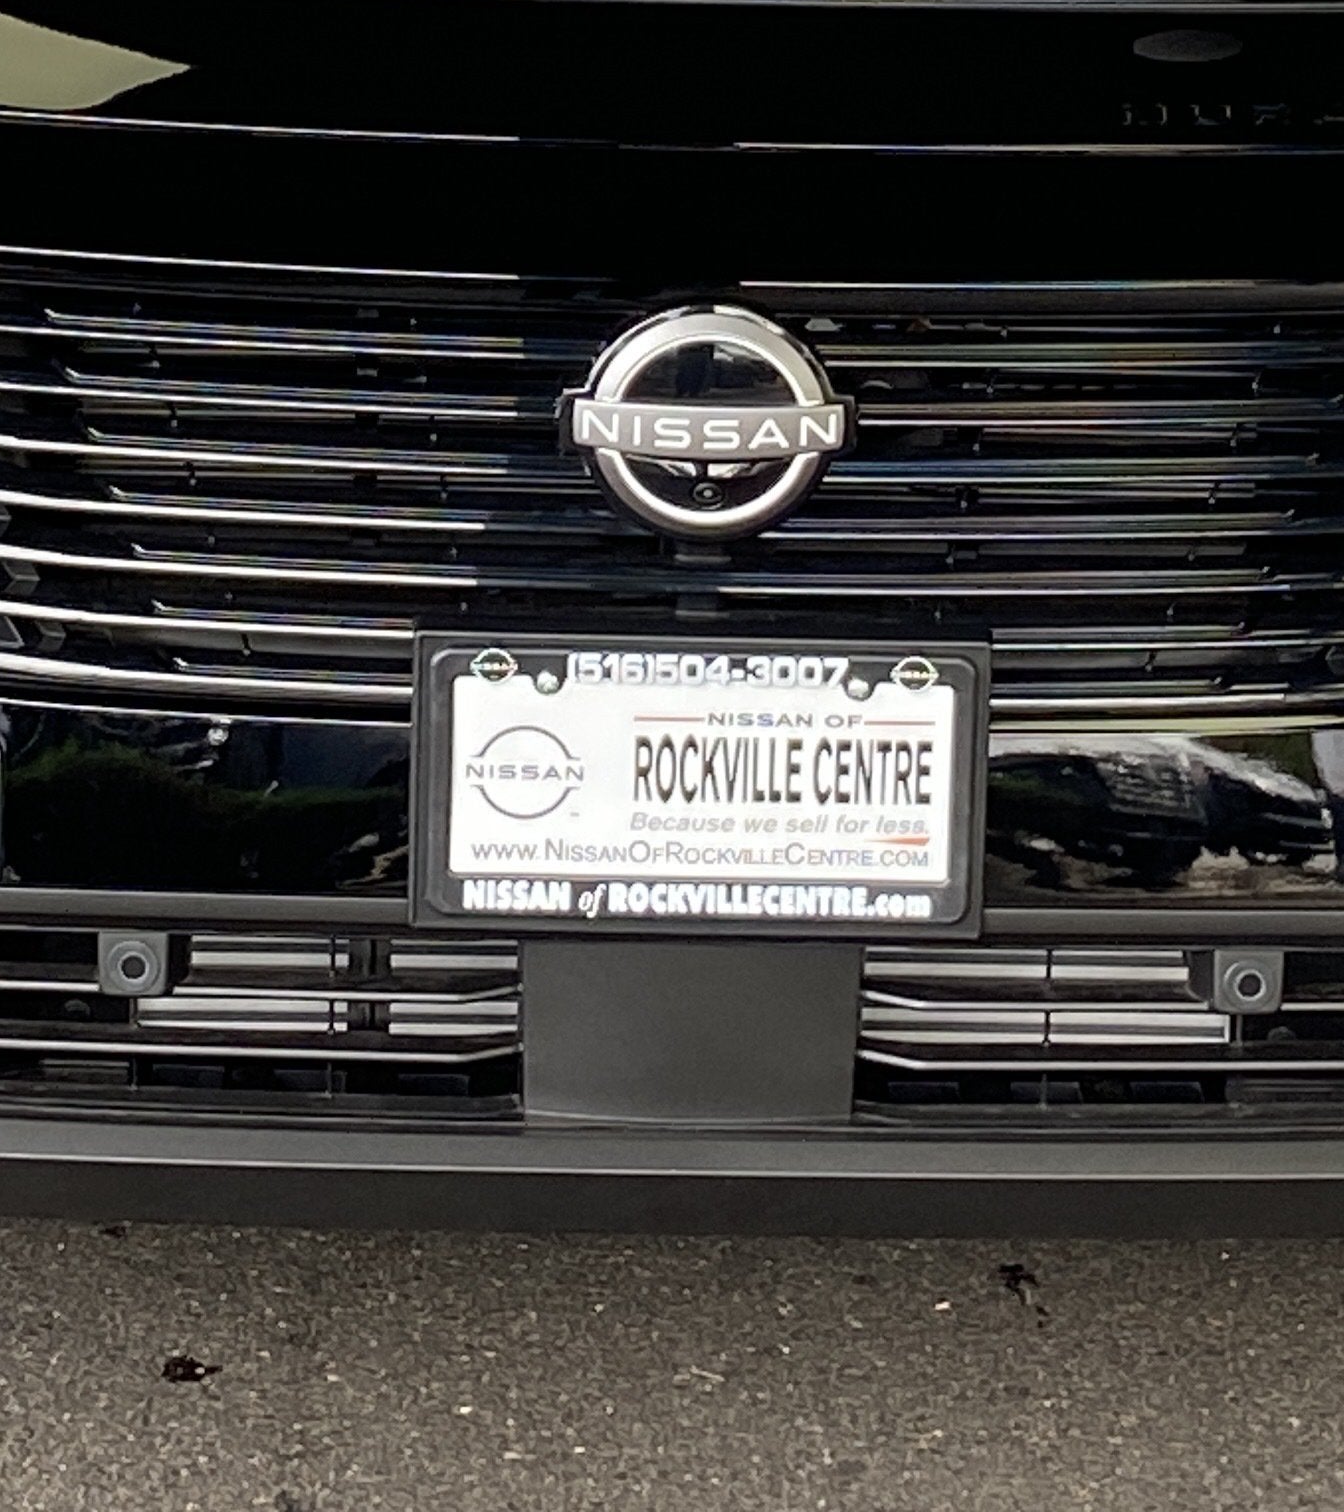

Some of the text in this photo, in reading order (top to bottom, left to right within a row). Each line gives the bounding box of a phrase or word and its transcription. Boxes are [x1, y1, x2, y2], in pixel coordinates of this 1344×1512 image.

[581, 408, 838, 450] NISSAN
[567, 652, 849, 687] (516)504-3007
[707, 712, 863, 728] NISSAN OF
[465, 763, 585, 781] NISSAN
[633, 734, 934, 806] ROCKVILLE CENTRE
[630, 812, 931, 835] Because we sell for less.
[462, 879, 572, 911] NISSAN
[578, 883, 607, 919] of
